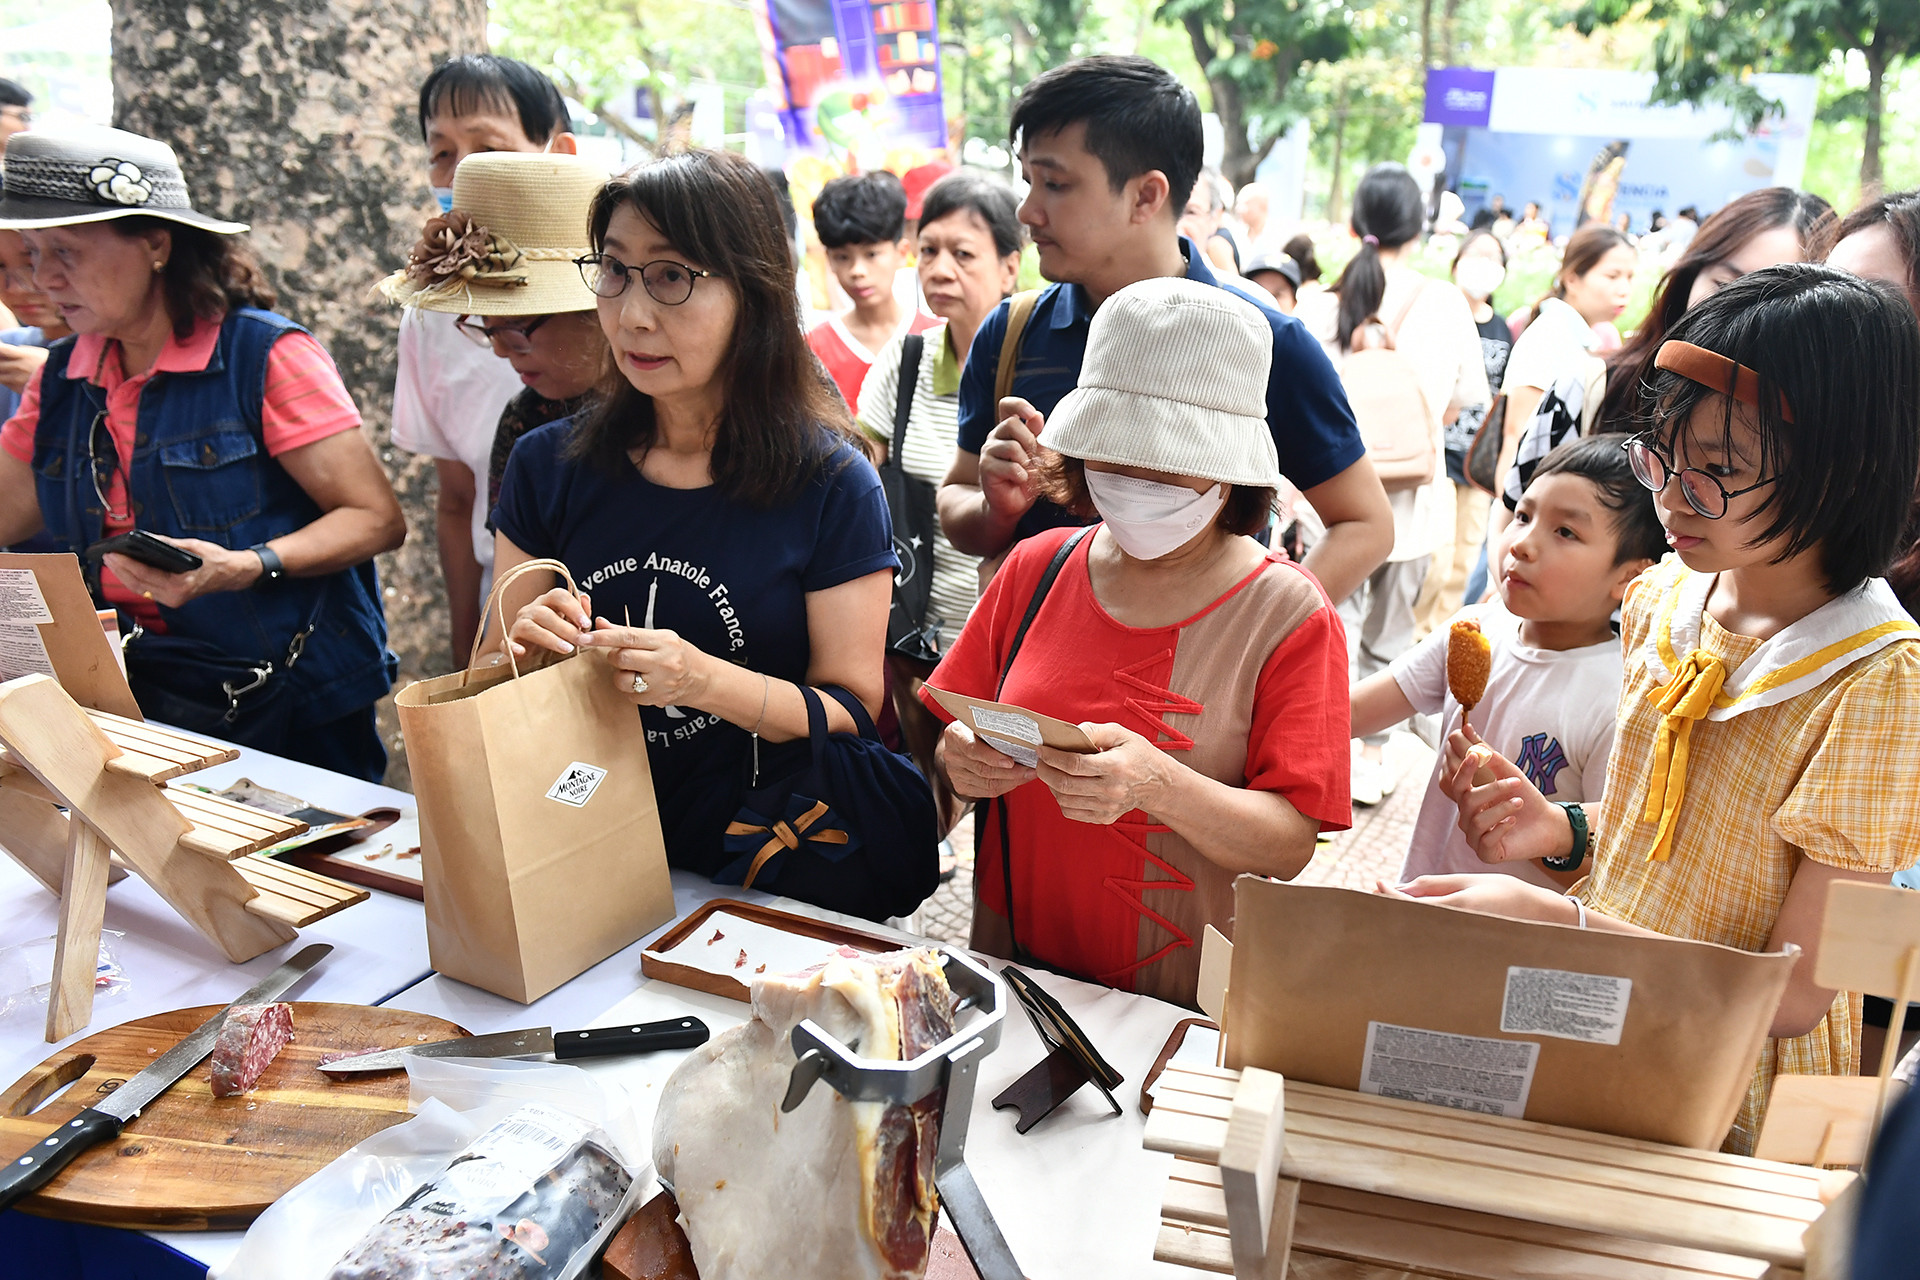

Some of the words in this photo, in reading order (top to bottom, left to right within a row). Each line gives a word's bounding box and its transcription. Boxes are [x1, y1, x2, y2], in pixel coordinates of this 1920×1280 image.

[579, 556, 638, 593] venue
[643, 552, 711, 589] Anatole
[708, 583, 746, 652] France,
[647, 730, 670, 747] La
[555, 772, 596, 797] MONTAGNE
[569, 784, 589, 797] NOIRE
